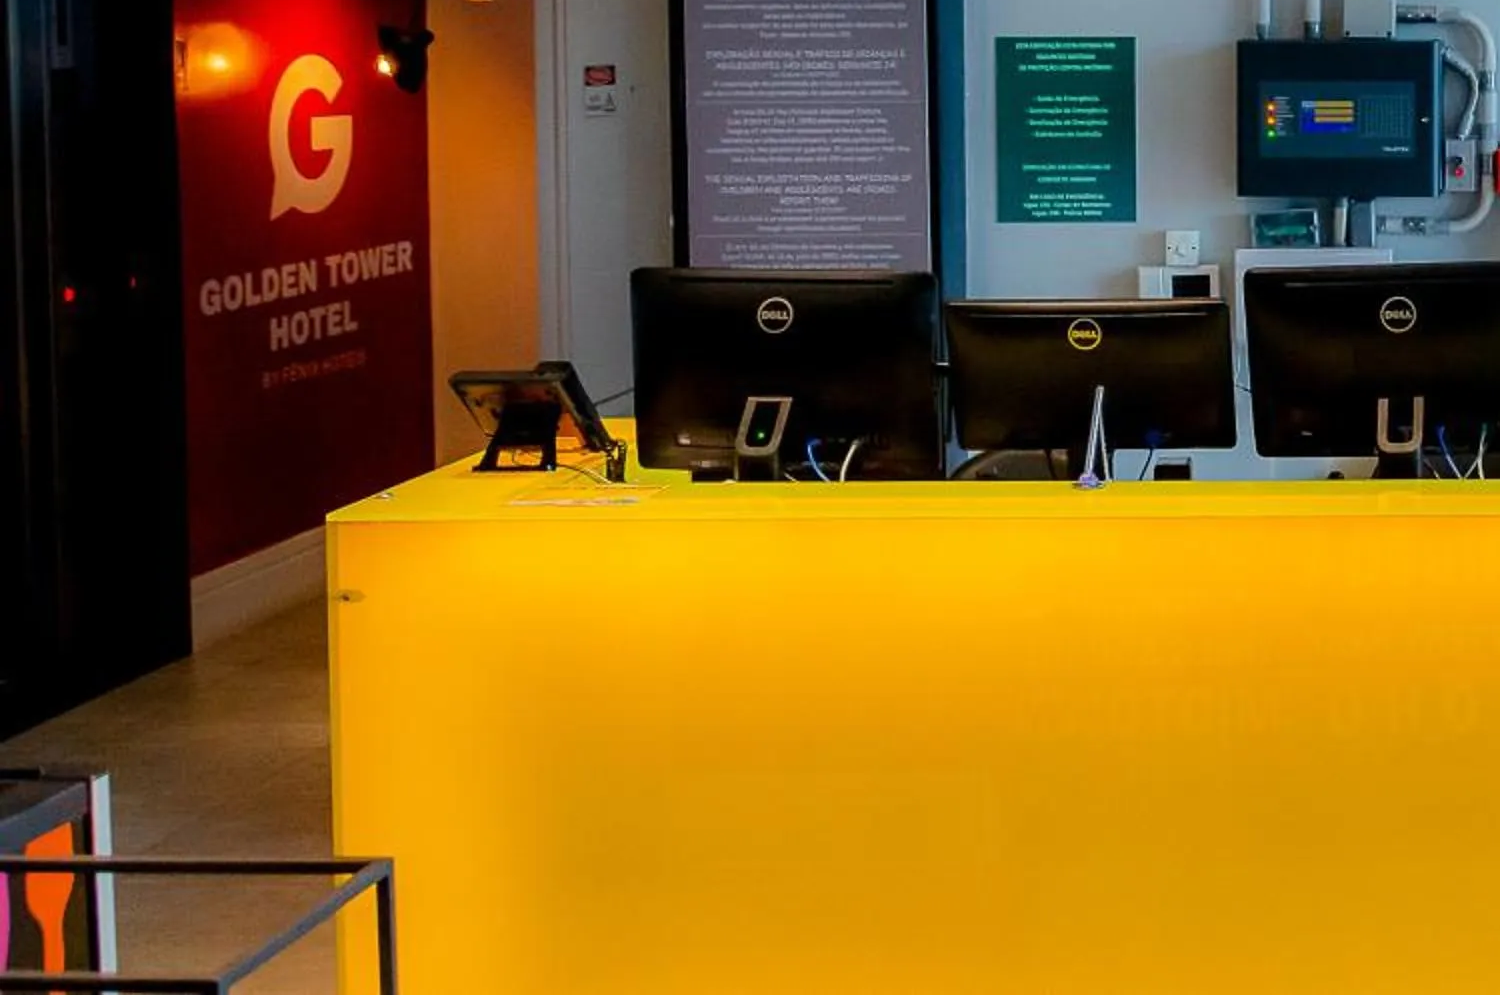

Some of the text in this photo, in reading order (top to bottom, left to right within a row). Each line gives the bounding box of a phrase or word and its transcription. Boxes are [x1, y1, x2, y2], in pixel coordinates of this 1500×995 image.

[200, 240, 414, 317] GOLDEN TOWER
[270, 300, 359, 352] HOTEL
[761, 309, 789, 320] DELL
[1385, 308, 1413, 320] DELL
